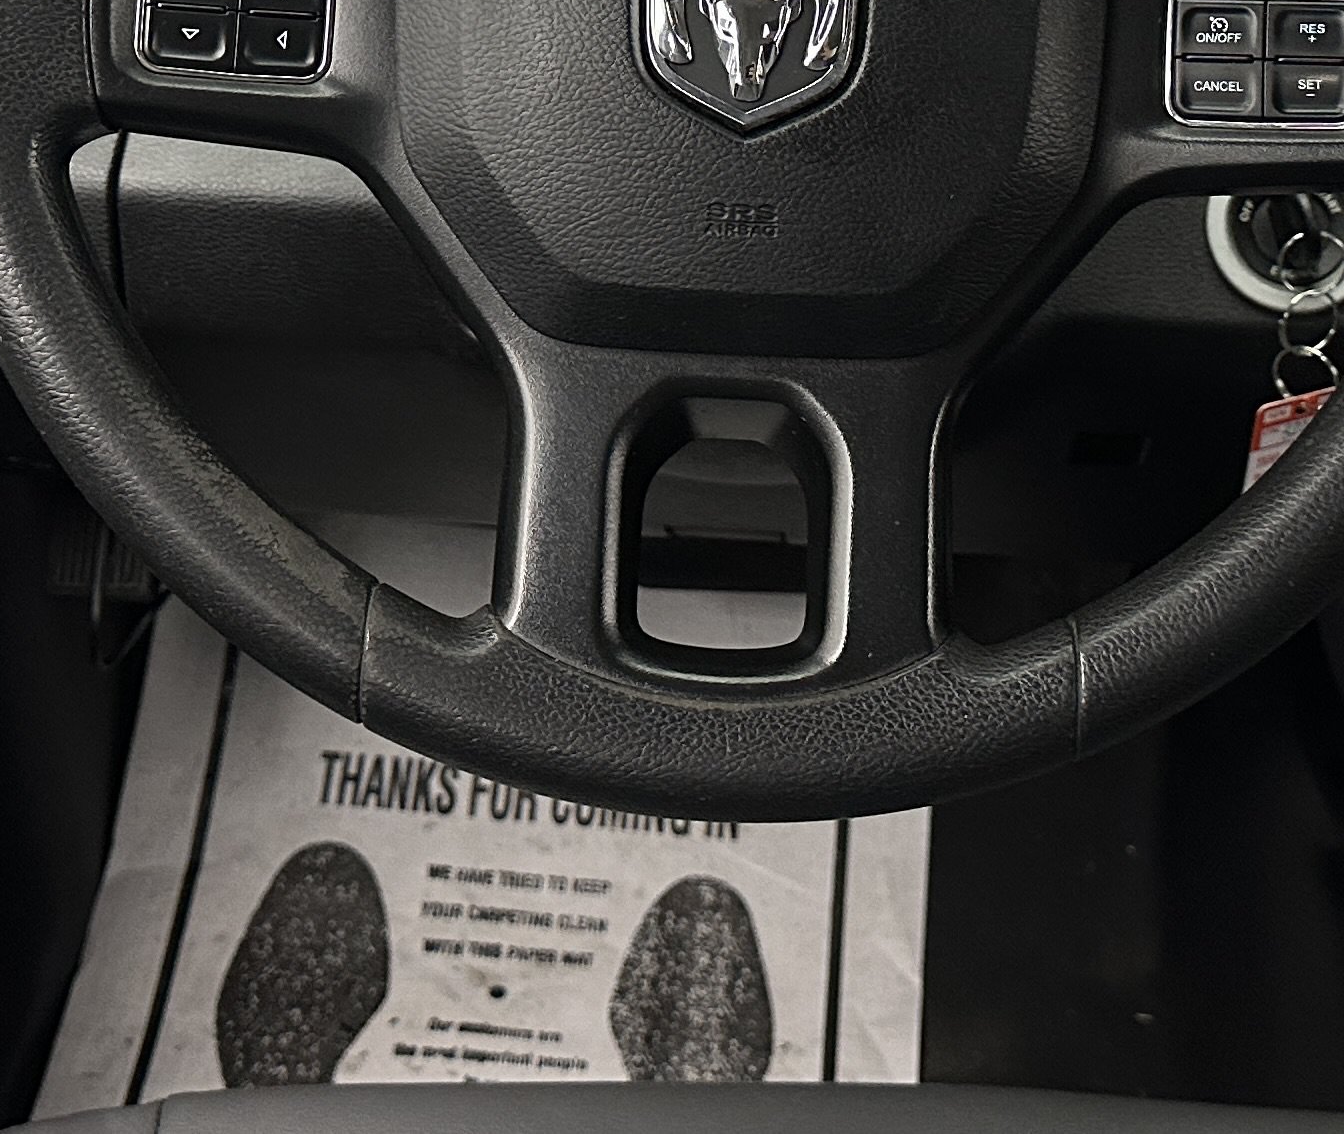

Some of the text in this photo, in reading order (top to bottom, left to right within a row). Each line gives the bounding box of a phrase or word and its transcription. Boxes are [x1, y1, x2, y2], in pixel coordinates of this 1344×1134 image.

[1299, 23, 1326, 35] RES
[1195, 32, 1243, 43] ON/OFF
[1193, 81, 1244, 93] CANCEL
[1297, 78, 1323, 91] SET
[319, 750, 459, 815] THANKS
